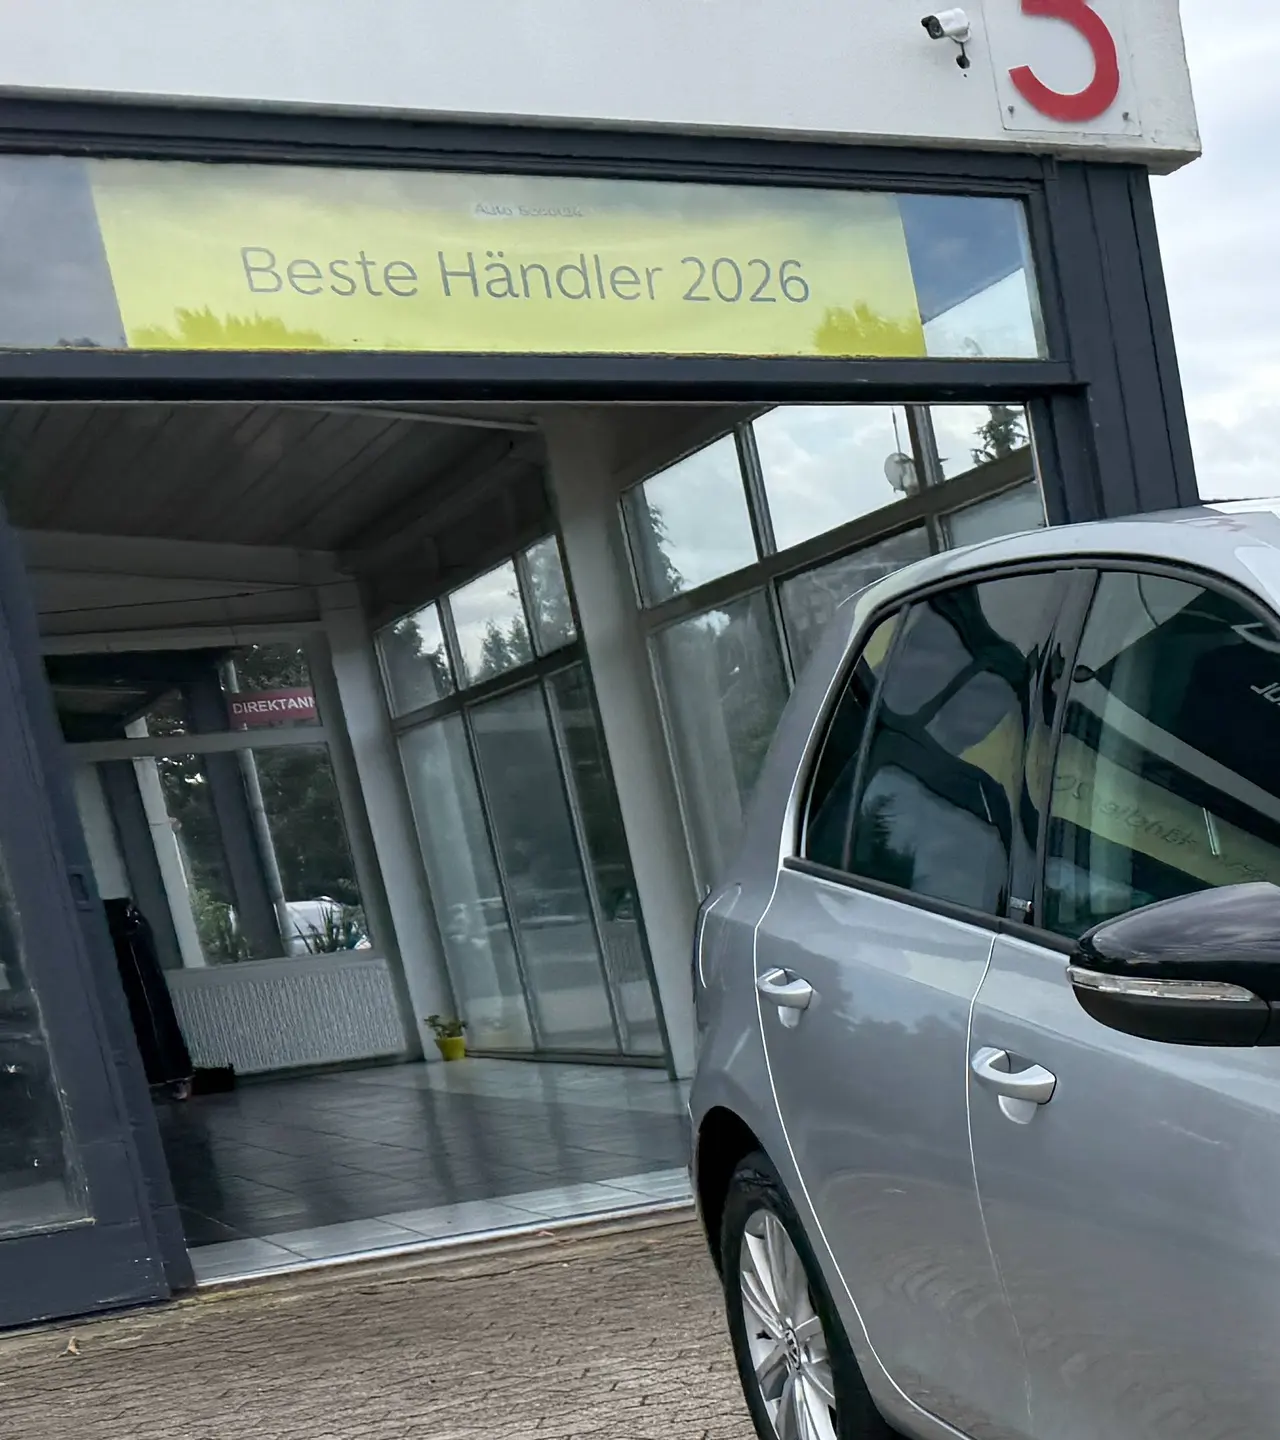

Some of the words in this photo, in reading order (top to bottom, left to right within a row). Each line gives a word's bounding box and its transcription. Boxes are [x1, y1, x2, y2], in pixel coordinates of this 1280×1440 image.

[241, 246, 418, 297] Beste
[437, 250, 663, 300] Händler
[681, 256, 810, 302] 2026
